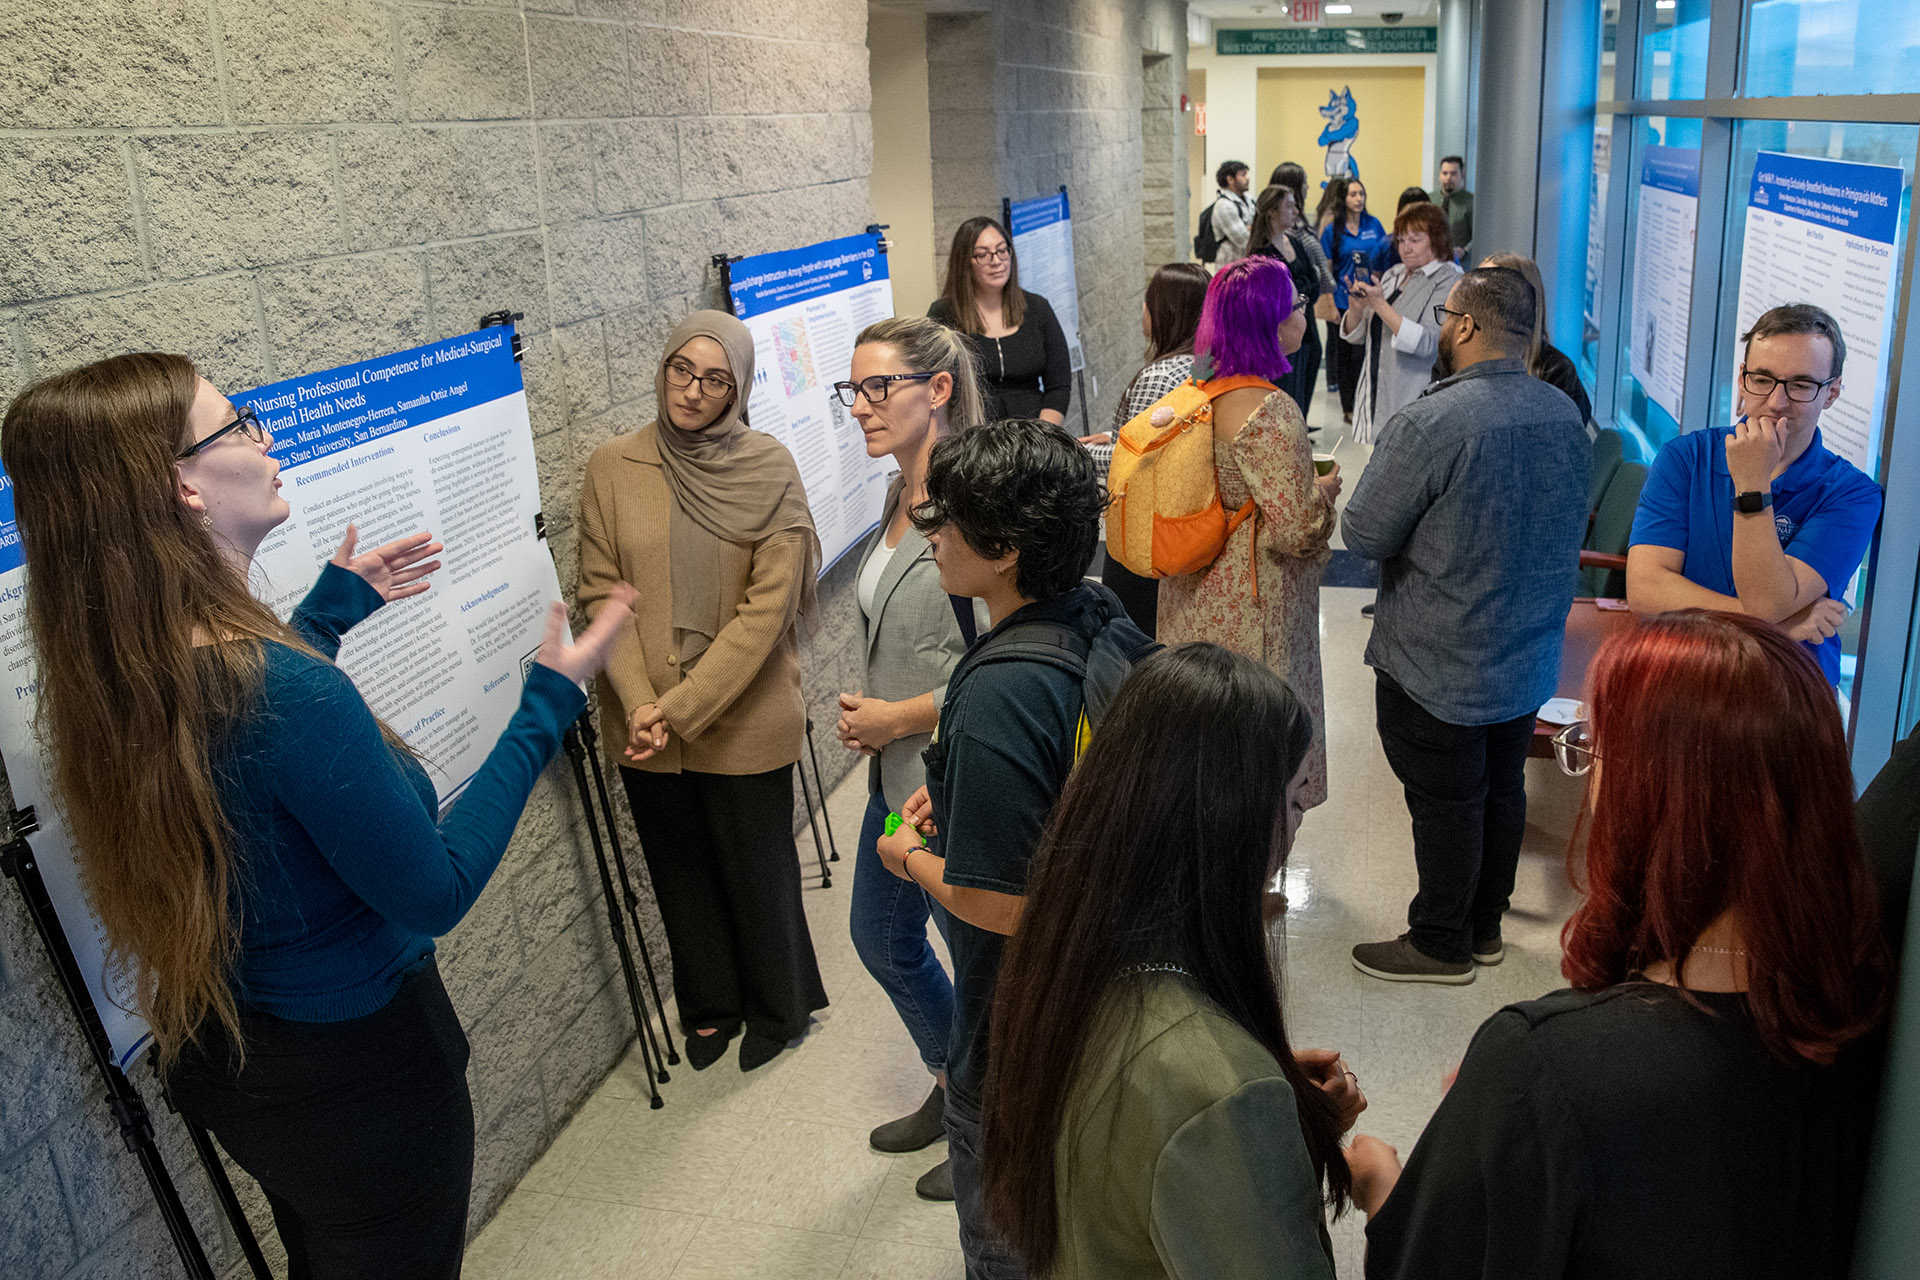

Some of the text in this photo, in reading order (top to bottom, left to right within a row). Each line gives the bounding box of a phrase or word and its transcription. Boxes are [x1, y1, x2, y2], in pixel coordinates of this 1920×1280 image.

[1293, 0, 1319, 22] EXIT
[1222, 42, 1266, 53] HISTORY
[1274, 42, 1312, 53] SOCIAL
[1384, 30, 1427, 41] PORTER
[1871, 245, 1888, 257] Practice
[252, 335, 501, 414] Nursing Professional Competence for Medical-Surgical
[260, 392, 366, 435] Mental Health Needs
[267, 381, 468, 452] ontes, Maria Montenegro-Herrera, Samantha Ortiz Angel
[290, 450, 311, 463] State
[312, 436, 354, 456] University,
[353, 431, 368, 442] San
[369, 418, 407, 437] Bernardino
[424, 424, 462, 443] Conclusions
[295, 460, 350, 488] Recommended
[351, 446, 396, 468] Interventions
[302, 502, 325, 514] Conduct
[332, 490, 356, 503] education
[357, 484, 373, 493] session
[306, 515, 325, 526] manage
[326, 507, 345, 520] patients
[346, 502, 357, 510] who
[358, 496, 371, 506] might
[378, 489, 391, 500] going
[391, 481, 409, 492] through
[309, 522, 335, 538] psychiatric
[336, 512, 362, 526] emergency
[363, 506, 372, 515] and
[372, 501, 386, 511] acting
[405, 488, 421, 497] nurses
[312, 538, 322, 548] will
[316, 548, 333, 560] include
[356, 540, 379, 554] upholding
[379, 529, 403, 543] medication
[461, 583, 509, 611] Acknowledgments
[2, 612, 16, 624] San
[354, 624, 378, 638] Mentoring
[378, 613, 398, 627] programs
[398, 606, 407, 615] will
[342, 649, 354, 659] offer
[354, 636, 378, 652] knowledge
[379, 629, 388, 639] and
[388, 618, 408, 634] emotional
[409, 610, 424, 622] support
[346, 612, 442, 670] registered nurses who need more guidance and
[369, 660, 380, 669] areas
[380, 654, 386, 662] of
[386, 640, 413, 659] improvement
[389, 656, 409, 670] Ensuring
[408, 650, 417, 658] that
[417, 643, 431, 653] nurses
[414, 654, 428, 666] mental
[393, 689, 415, 704] specialists
[415, 681, 423, 690] will
[423, 673, 441, 687] progress
[397, 680, 406, 690] and
[484, 672, 510, 694] References
[414, 708, 445, 732] of Practice
